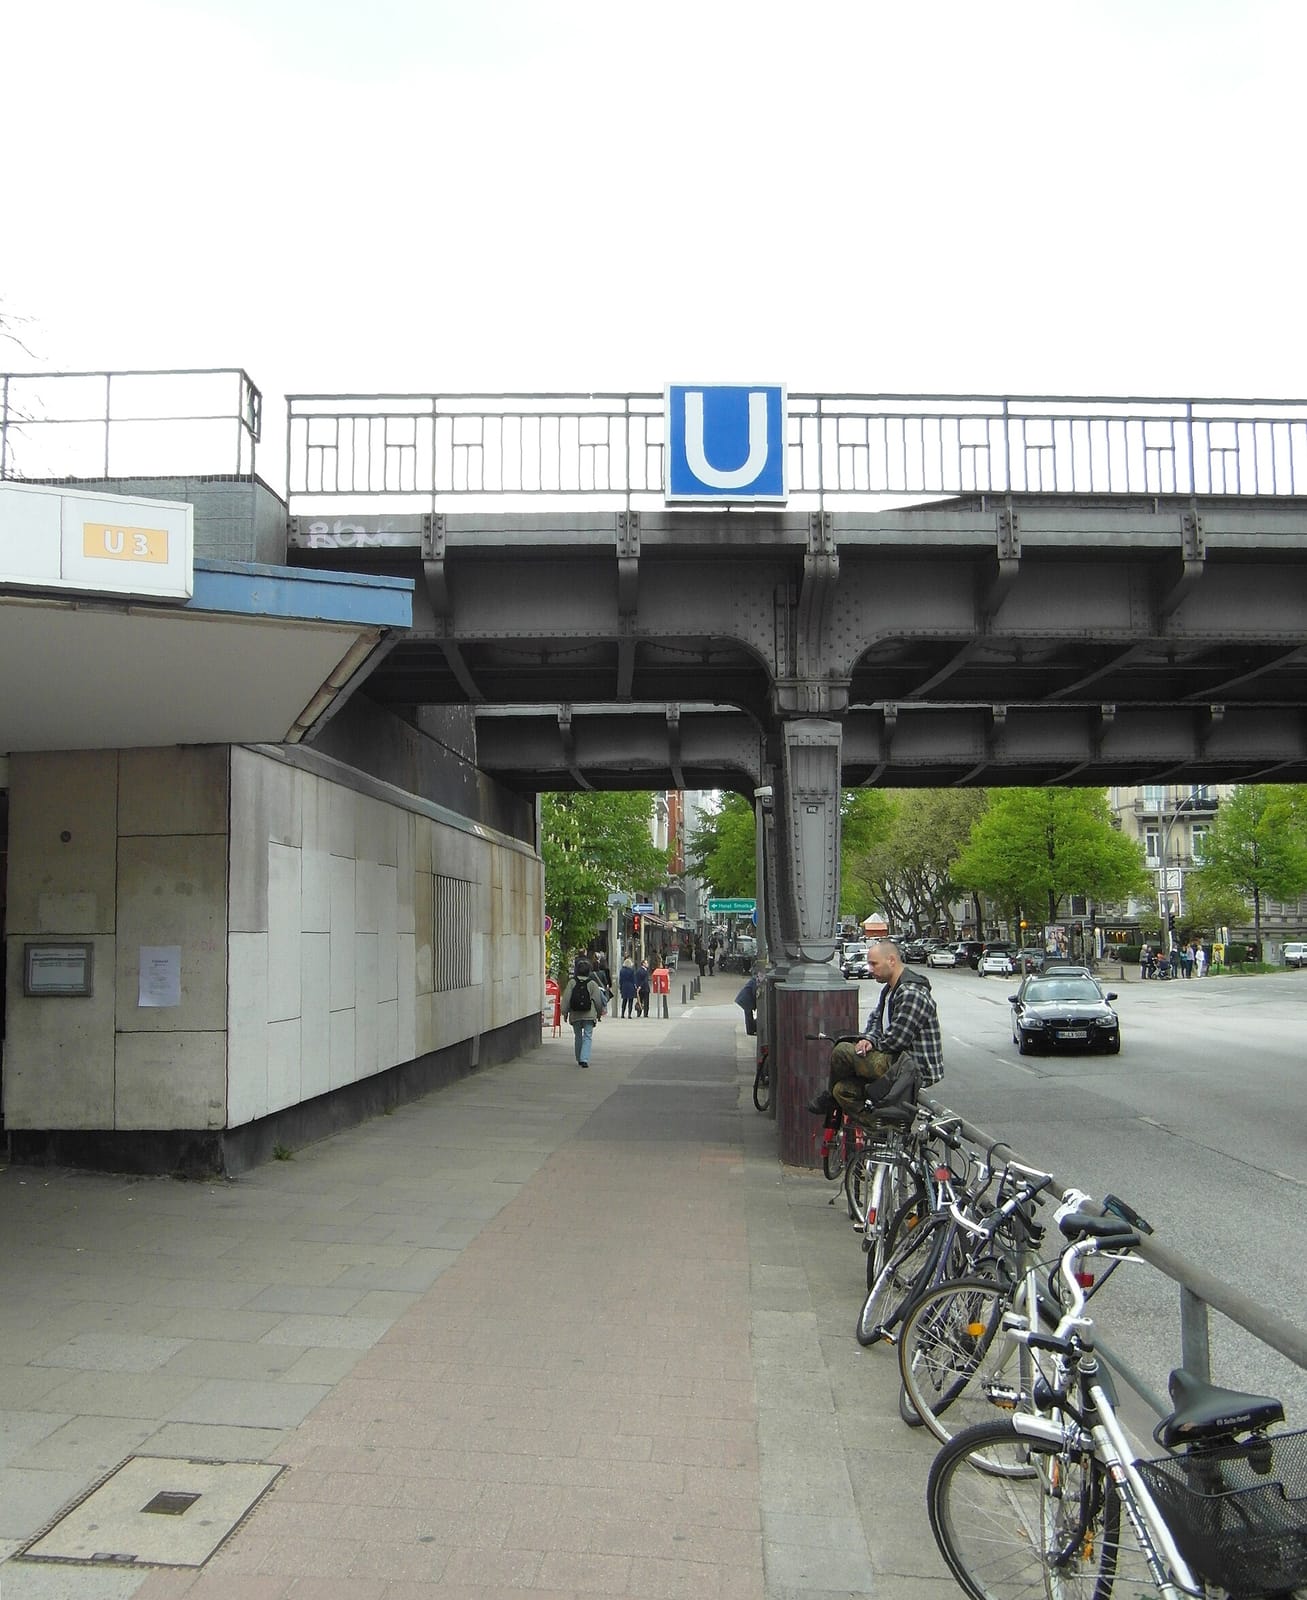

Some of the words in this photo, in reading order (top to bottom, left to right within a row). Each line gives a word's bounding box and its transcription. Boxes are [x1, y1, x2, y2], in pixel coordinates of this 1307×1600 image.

[685, 392, 768, 489] U
[104, 530, 124, 554] U
[133, 534, 148, 555] 3
